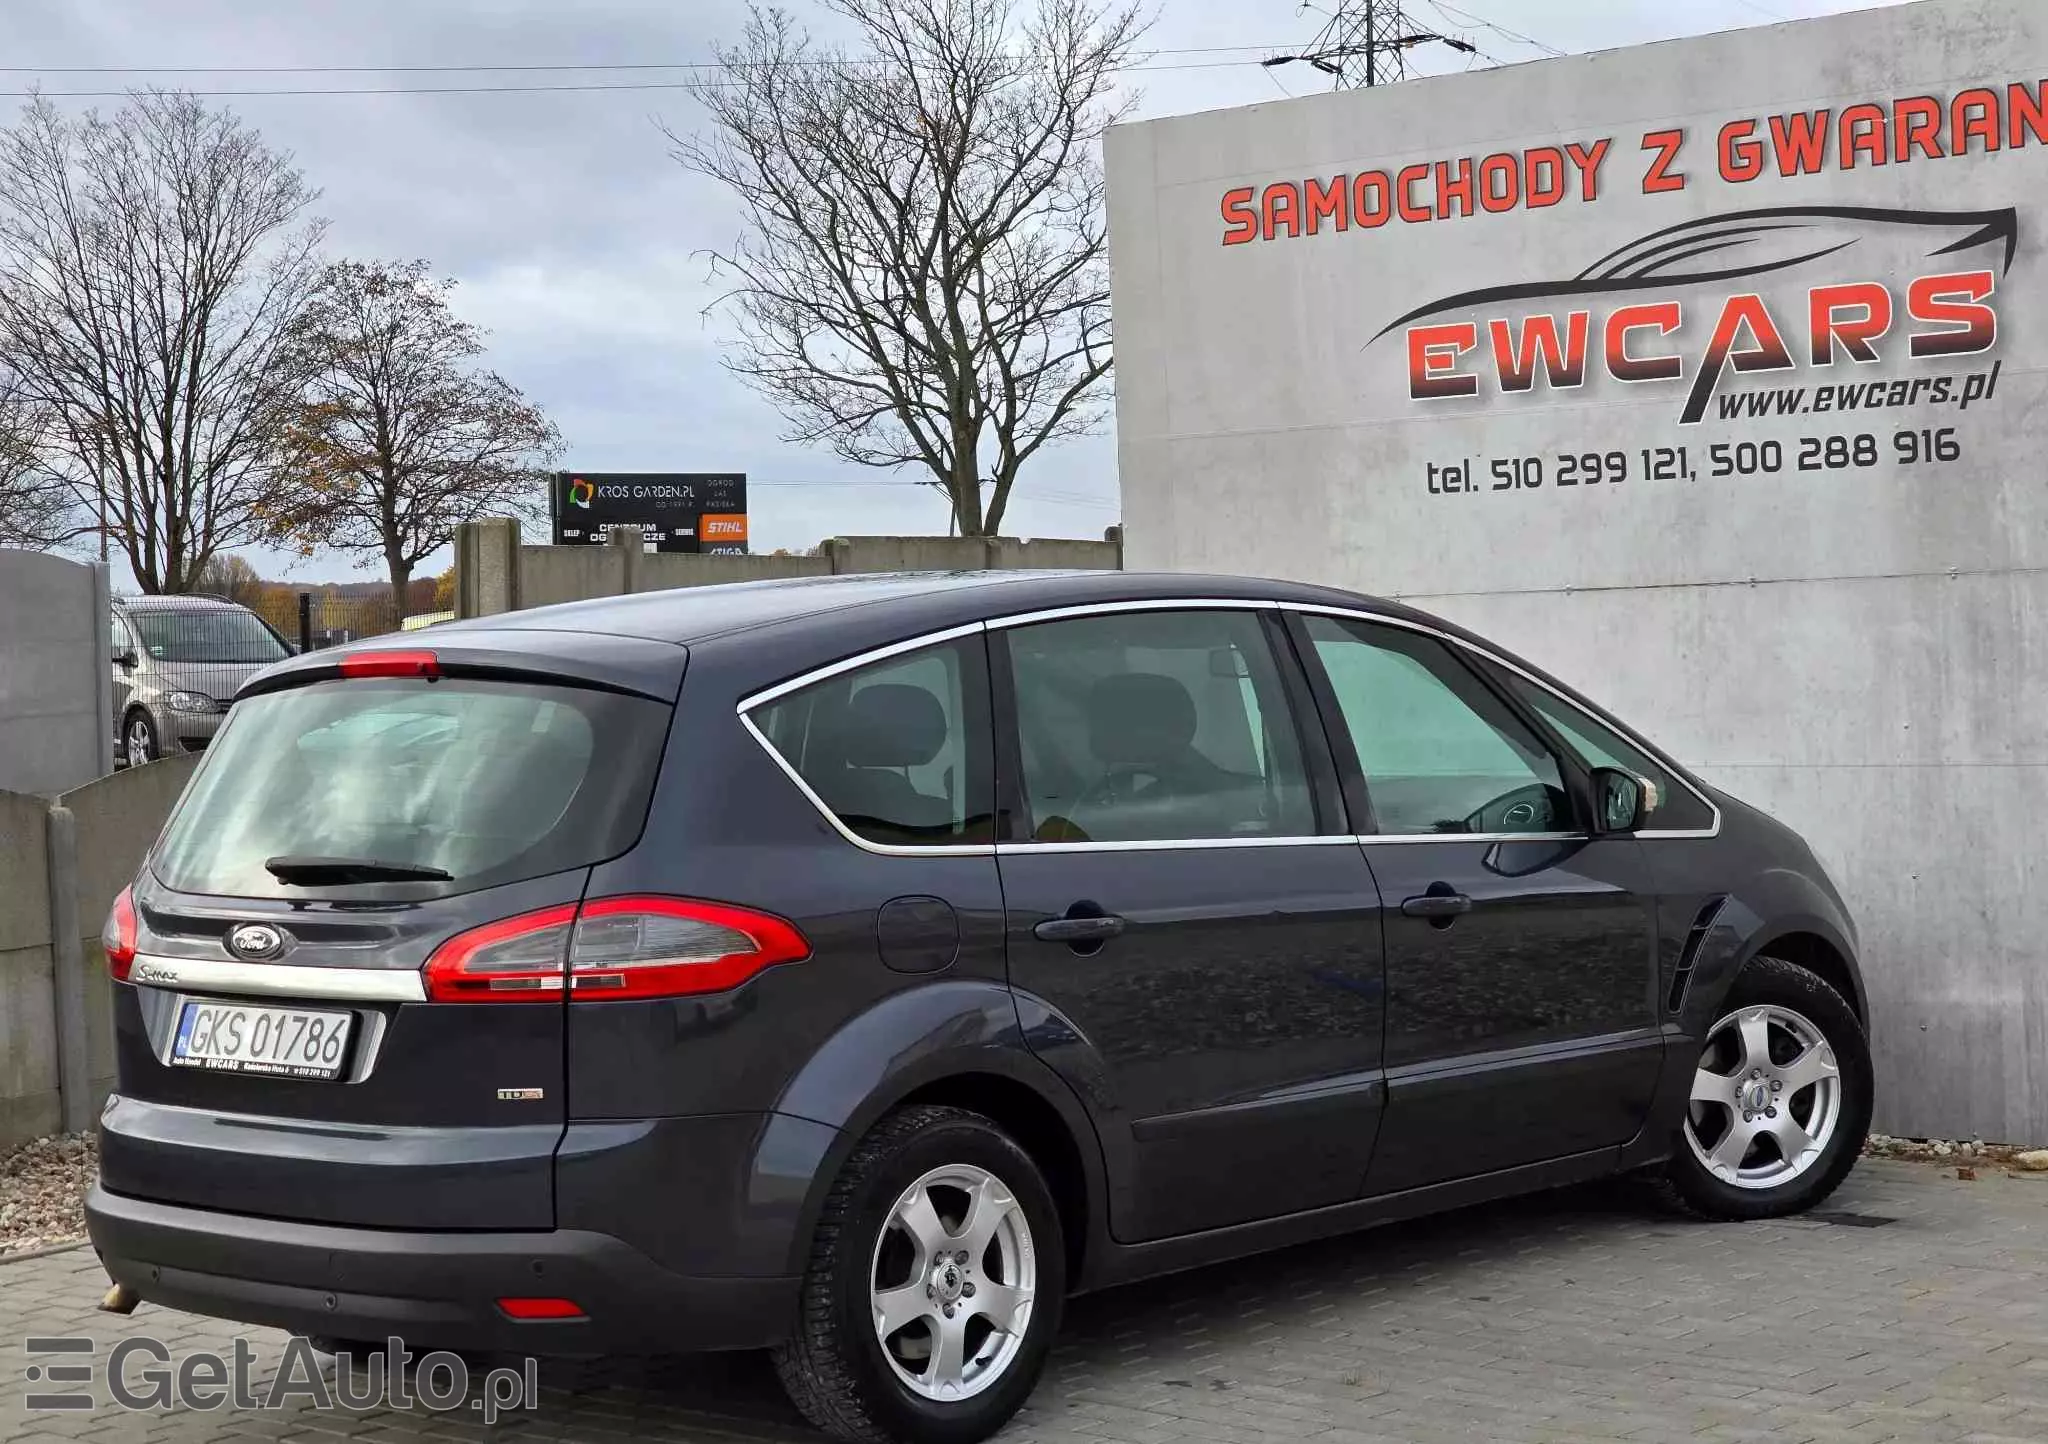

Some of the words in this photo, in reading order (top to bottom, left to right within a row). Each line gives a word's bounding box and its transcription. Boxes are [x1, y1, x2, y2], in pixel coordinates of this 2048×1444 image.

[1222, 138, 1612, 246] SAMOCHODY
[1640, 127, 1685, 195] Z
[1716, 79, 2048, 184] GWARAN
[1406, 269, 1998, 426] EWCARS
[1718, 359, 2001, 421] www.ewcars.pl
[1427, 459, 1479, 495] tel.
[1491, 456, 1543, 491] 510
[1556, 450, 1627, 485] 299
[1640, 445, 1697, 483] 121,
[1711, 439, 1782, 477] 500
[1797, 432, 1878, 470] 288
[1895, 426, 1960, 465] 916
[597, 485, 629, 499] KROS
[633, 485, 695, 499] GARDEN.PL
[707, 521, 745, 533] STIHL
[191, 1008, 246, 1055] GKS
[249, 1013, 346, 1063] 01786
[205, 1058, 239, 1070] EWCARS
